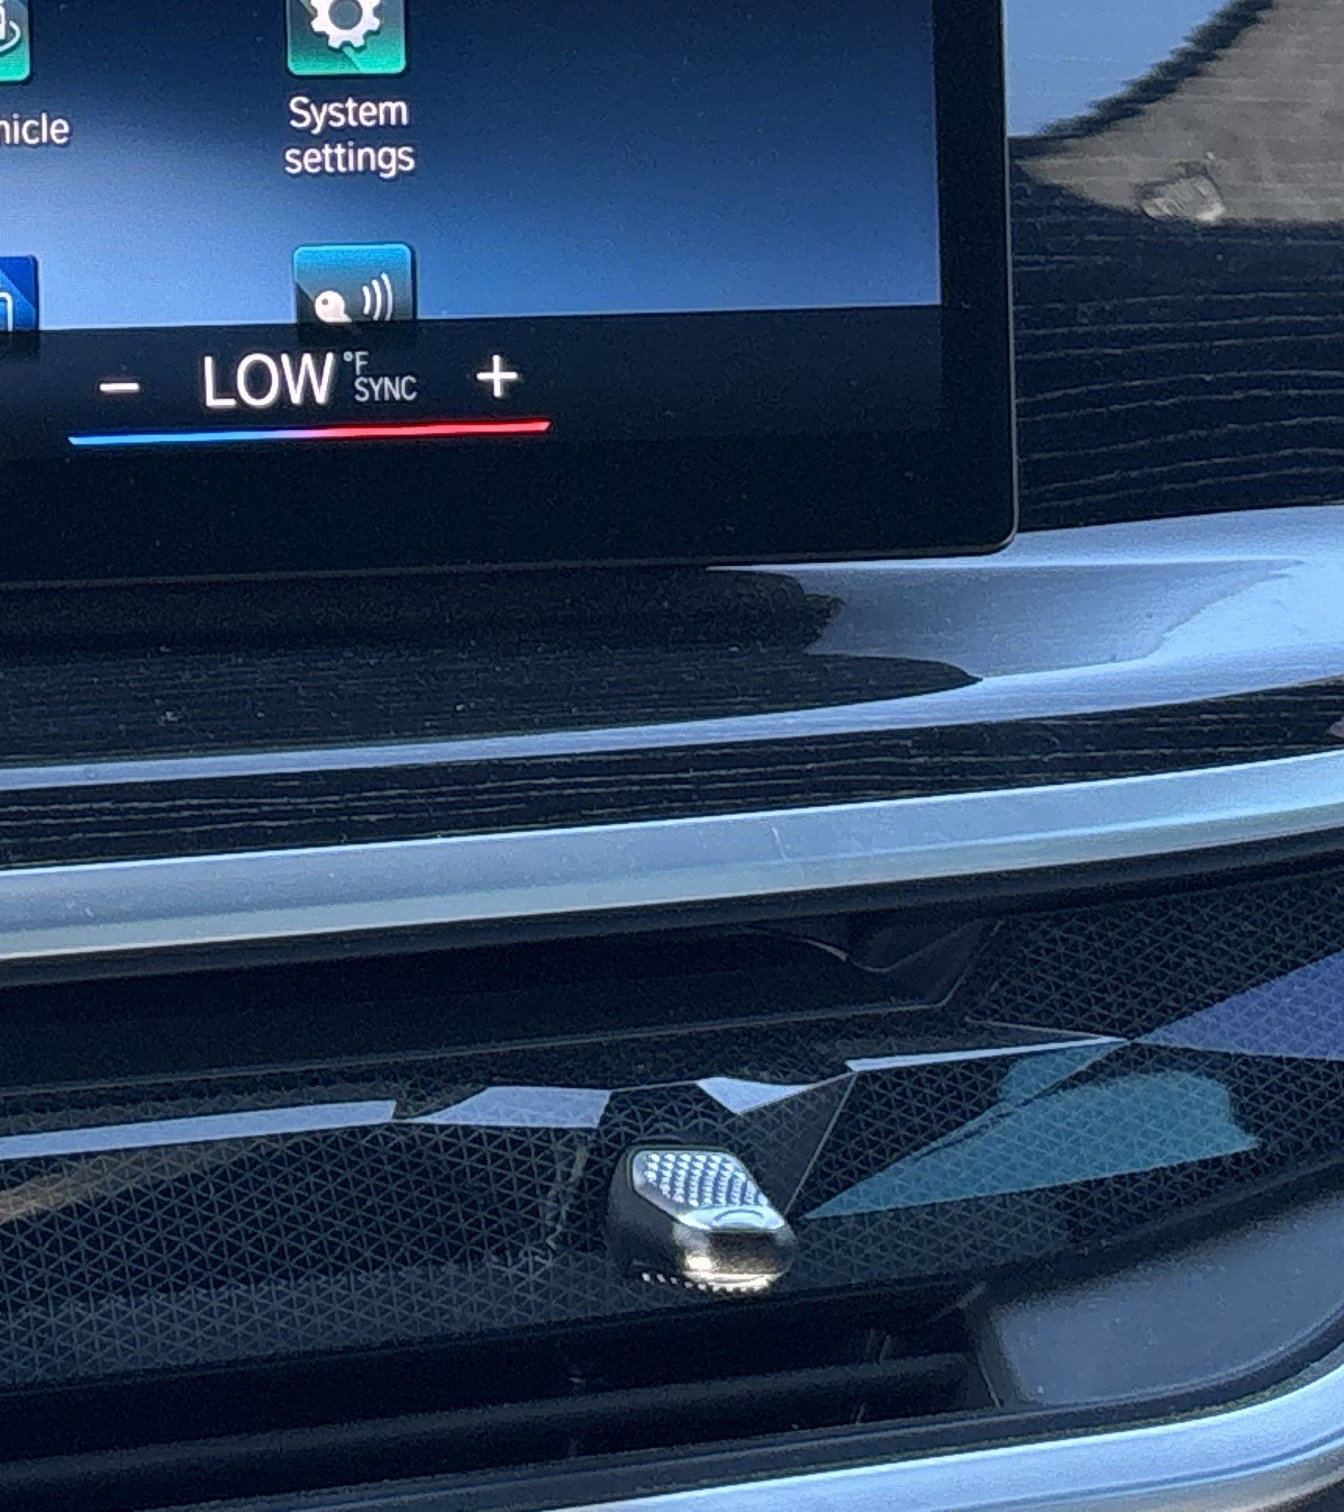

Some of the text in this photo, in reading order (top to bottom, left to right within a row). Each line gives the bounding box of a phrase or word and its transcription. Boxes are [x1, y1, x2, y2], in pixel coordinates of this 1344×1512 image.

[288, 96, 409, 134] System
[284, 142, 415, 178] settings
[203, 352, 335, 408] LOW
[354, 375, 418, 402] SYNC
